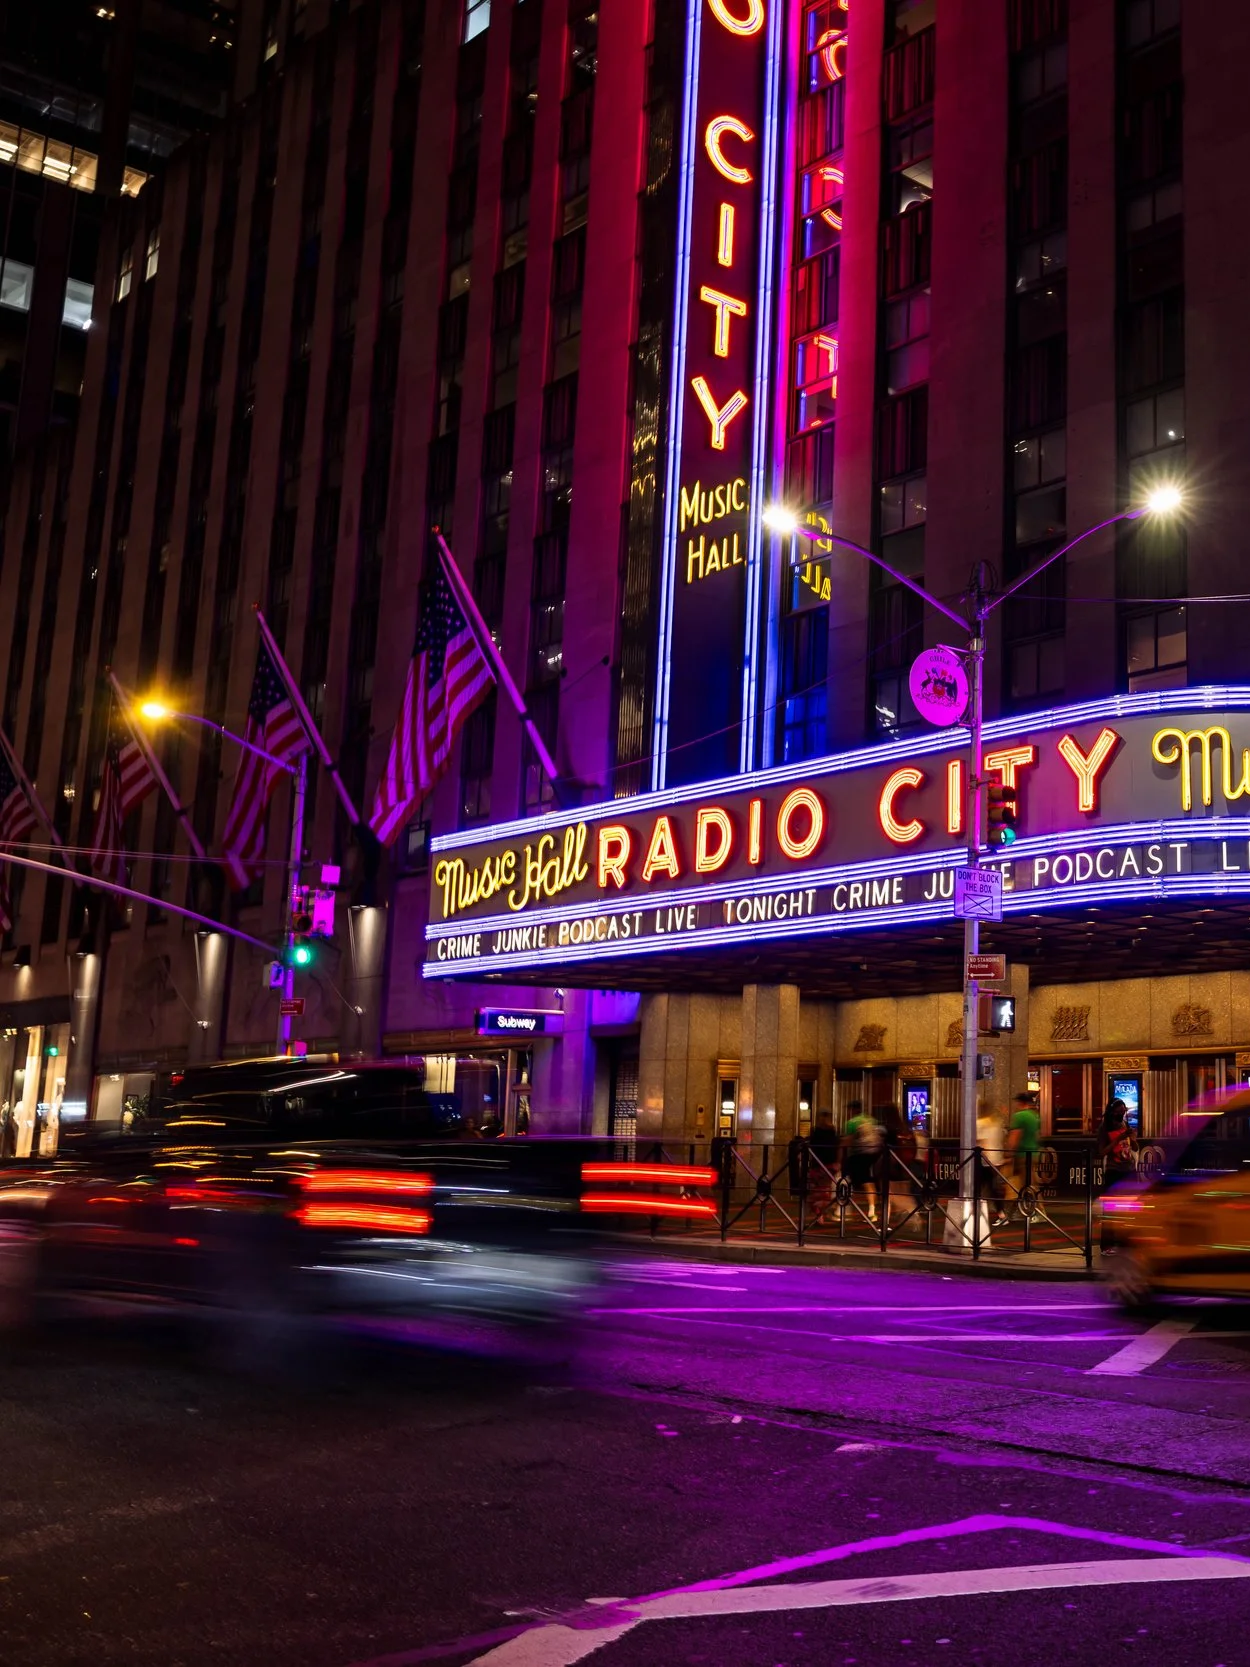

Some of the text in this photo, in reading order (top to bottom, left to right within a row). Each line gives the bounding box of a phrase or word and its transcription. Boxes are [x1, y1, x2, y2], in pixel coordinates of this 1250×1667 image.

[691, 113, 755, 450] CITY
[680, 476, 746, 533] MUSIC
[687, 532, 743, 583] HALL
[597, 726, 1118, 889] RADIO CITY
[434, 821, 592, 918] Music Hall
[957, 870, 1000, 884] DON'T BLOCK
[965, 881, 993, 894] THE BOX
[437, 934, 482, 962] CRIME
[492, 925, 547, 954] JUNKIE
[558, 912, 643, 946] PODCAST
[655, 905, 696, 935] LIVE
[724, 888, 818, 925] TONIGHT
[833, 877, 904, 912] CRIME
[924, 862, 1012, 901] JUE
[1034, 843, 1188, 888] PODCAST
[497, 1015, 536, 1031] Subway
